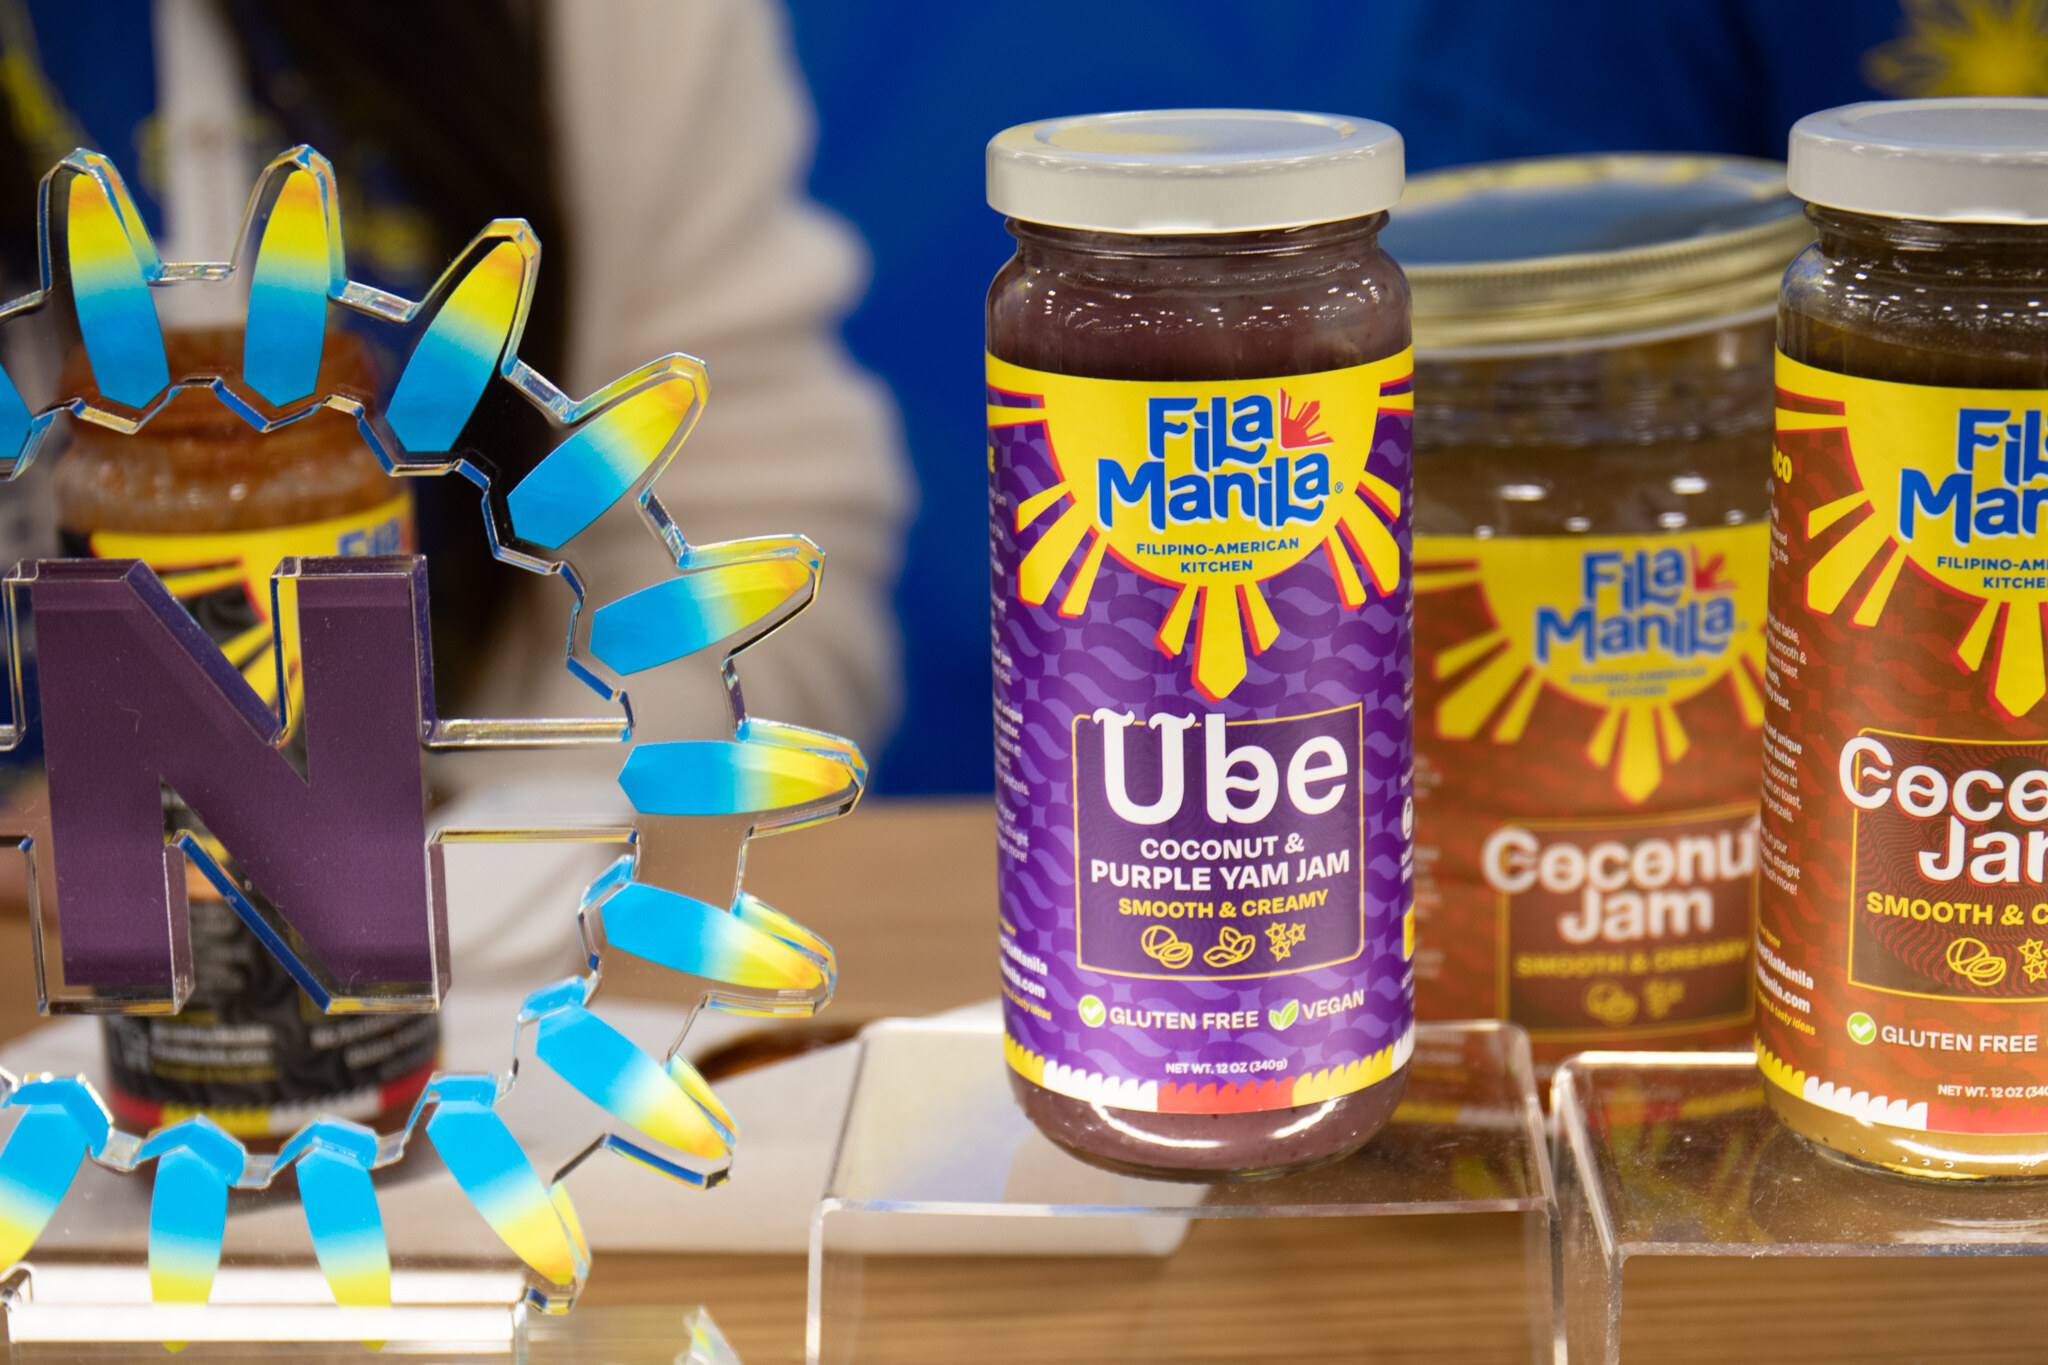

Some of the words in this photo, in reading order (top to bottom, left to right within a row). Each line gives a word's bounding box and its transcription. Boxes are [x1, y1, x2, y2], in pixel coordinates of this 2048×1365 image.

[1136, 537, 1300, 556] FILIPINO-AMERICAN
[1180, 559, 1253, 573] KITCHEN
[1937, 556, 2048, 571] FILIPINO-AM
[1983, 576, 2048, 589] KITCHE
[1777, 732, 1802, 755] unique
[1092, 707, 1348, 825] Ube
[1774, 745, 1797, 771] butter.
[1839, 736, 2048, 822] Coco
[1140, 835, 1279, 861] COCONUT
[1284, 832, 1305, 854] &
[1482, 820, 1760, 894] Coconu
[1091, 859, 1211, 891] PURPLE
[1219, 861, 1289, 890] YAM
[1296, 849, 1350, 883] JAM
[1118, 897, 1213, 918] SMOOTH
[1218, 901, 1237, 918] &
[1241, 889, 1328, 917] CREAMY
[1559, 886, 1714, 943] Jam
[1866, 891, 1993, 925] SMOOTH
[2000, 904, 2024, 926] &
[1516, 953, 1625, 977] SMOOTH
[1629, 953, 1648, 974] &
[1654, 940, 1749, 970] CREAMY
[1109, 1007, 1196, 1030] GLUTEN
[1202, 1010, 1259, 1031] FREE
[1302, 989, 1364, 1021] VEGAN
[1881, 1025, 1973, 1052] GLUTEN
[1979, 1034, 2038, 1053] FREE
[1165, 1063, 1189, 1074] NET
[1191, 1063, 1215, 1074] WT.
[1216, 1062, 1228, 1074] 12
[1230, 1062, 1248, 1074] OZ
[1249, 1058, 1288, 1074] (340g)
[1937, 1084, 1962, 1097] NET
[1964, 1086, 1989, 1098] WT.
[1990, 1087, 2003, 1098] 12
[2005, 1087, 2024, 1098] OZ
